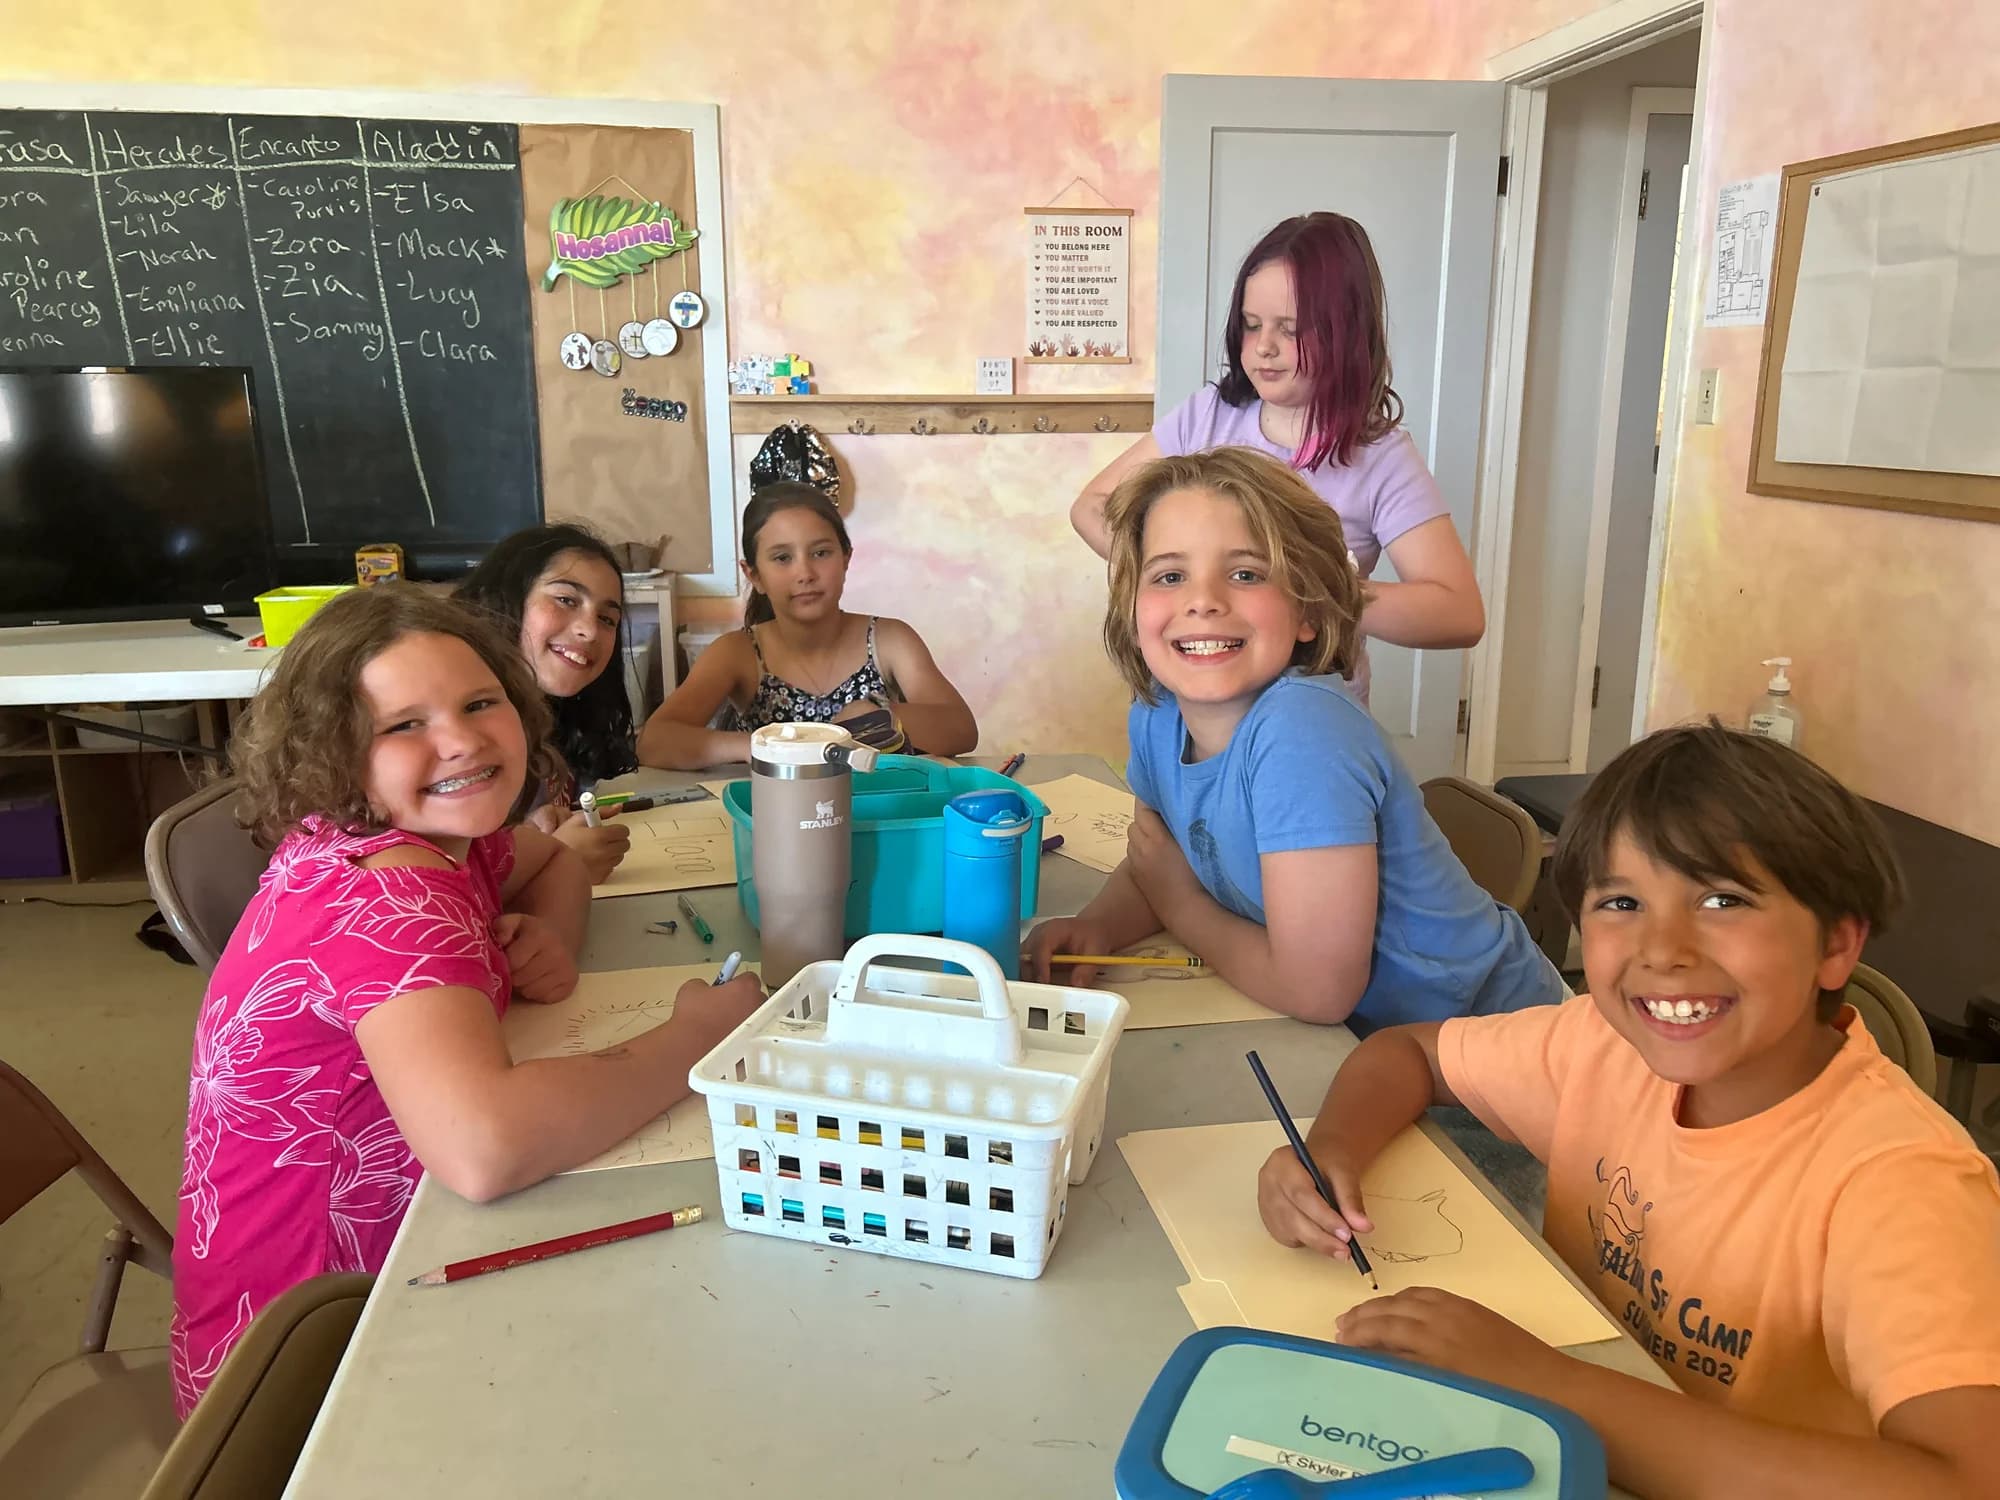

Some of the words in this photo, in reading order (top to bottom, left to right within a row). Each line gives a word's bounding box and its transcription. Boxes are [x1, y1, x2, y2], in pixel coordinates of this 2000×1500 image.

[238, 126, 341, 159] Encanto
[373, 125, 501, 162] Aladdin
[98, 129, 228, 170] Hercules
[1034, 225, 1047, 236] IN
[1052, 225, 1080, 237] THIS
[1085, 226, 1122, 237] ROOM
[555, 218, 674, 260] Hosanna!
[1045, 243, 1059, 251] YOU
[1061, 243, 1089, 251] BELONG
[1091, 243, 1111, 251] HERE
[1045, 254, 1059, 262] YOU
[1061, 254, 1089, 262] MATTER
[1045, 265, 1059, 273] YOU
[1061, 265, 1075, 273] ARE
[1078, 265, 1103, 273] WORTH
[1045, 276, 1059, 284] YOU
[1061, 276, 1075, 284] ARE
[1077, 276, 1118, 284] IMPORTANT
[1045, 287, 1059, 295] YOU
[1061, 287, 1075, 295] ARE
[1077, 287, 1100, 295] LOVED
[10, 288, 101, 327] Pearcy
[1045, 298, 1059, 306] YOU
[1061, 298, 1079, 306] HAVE
[1081, 298, 1086, 306] A
[1088, 298, 1109, 306] VOICE
[1045, 309, 1059, 317] YOU
[1061, 309, 1075, 317] ARE
[1077, 309, 1104, 317] VALUED
[1045, 320, 1059, 328] YOU
[1061, 320, 1075, 328] ARE
[1077, 320, 1118, 328] RESPECTED
[799, 816, 843, 830] STANLEY
[1686, 1350, 1737, 1386] 202
[1300, 1415, 1424, 1462] bentgo
[1295, 1457, 1348, 1479] Skyler
